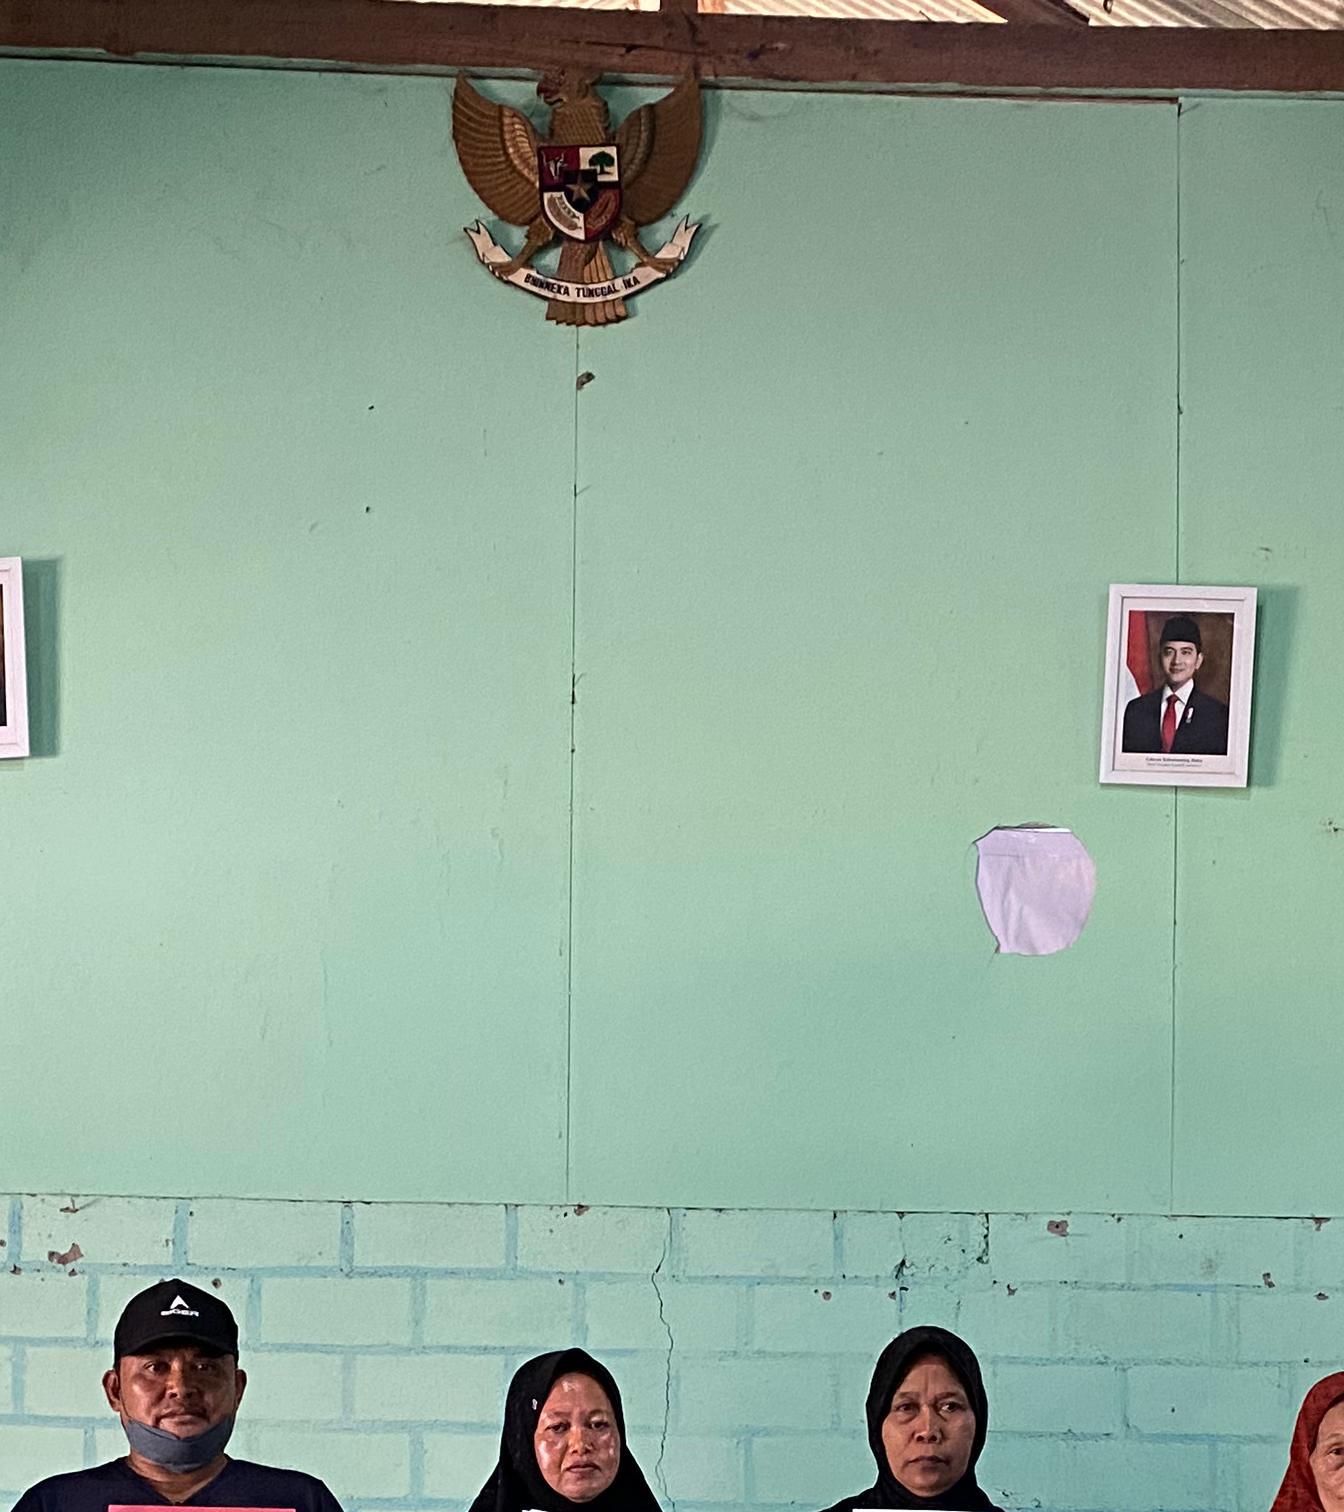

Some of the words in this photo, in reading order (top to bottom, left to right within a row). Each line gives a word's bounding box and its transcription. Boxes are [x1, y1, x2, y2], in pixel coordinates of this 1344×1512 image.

[524, 273, 570, 297] BHINNEKA
[575, 282, 620, 298] TUNGGAL
[623, 276, 641, 290] IKA
